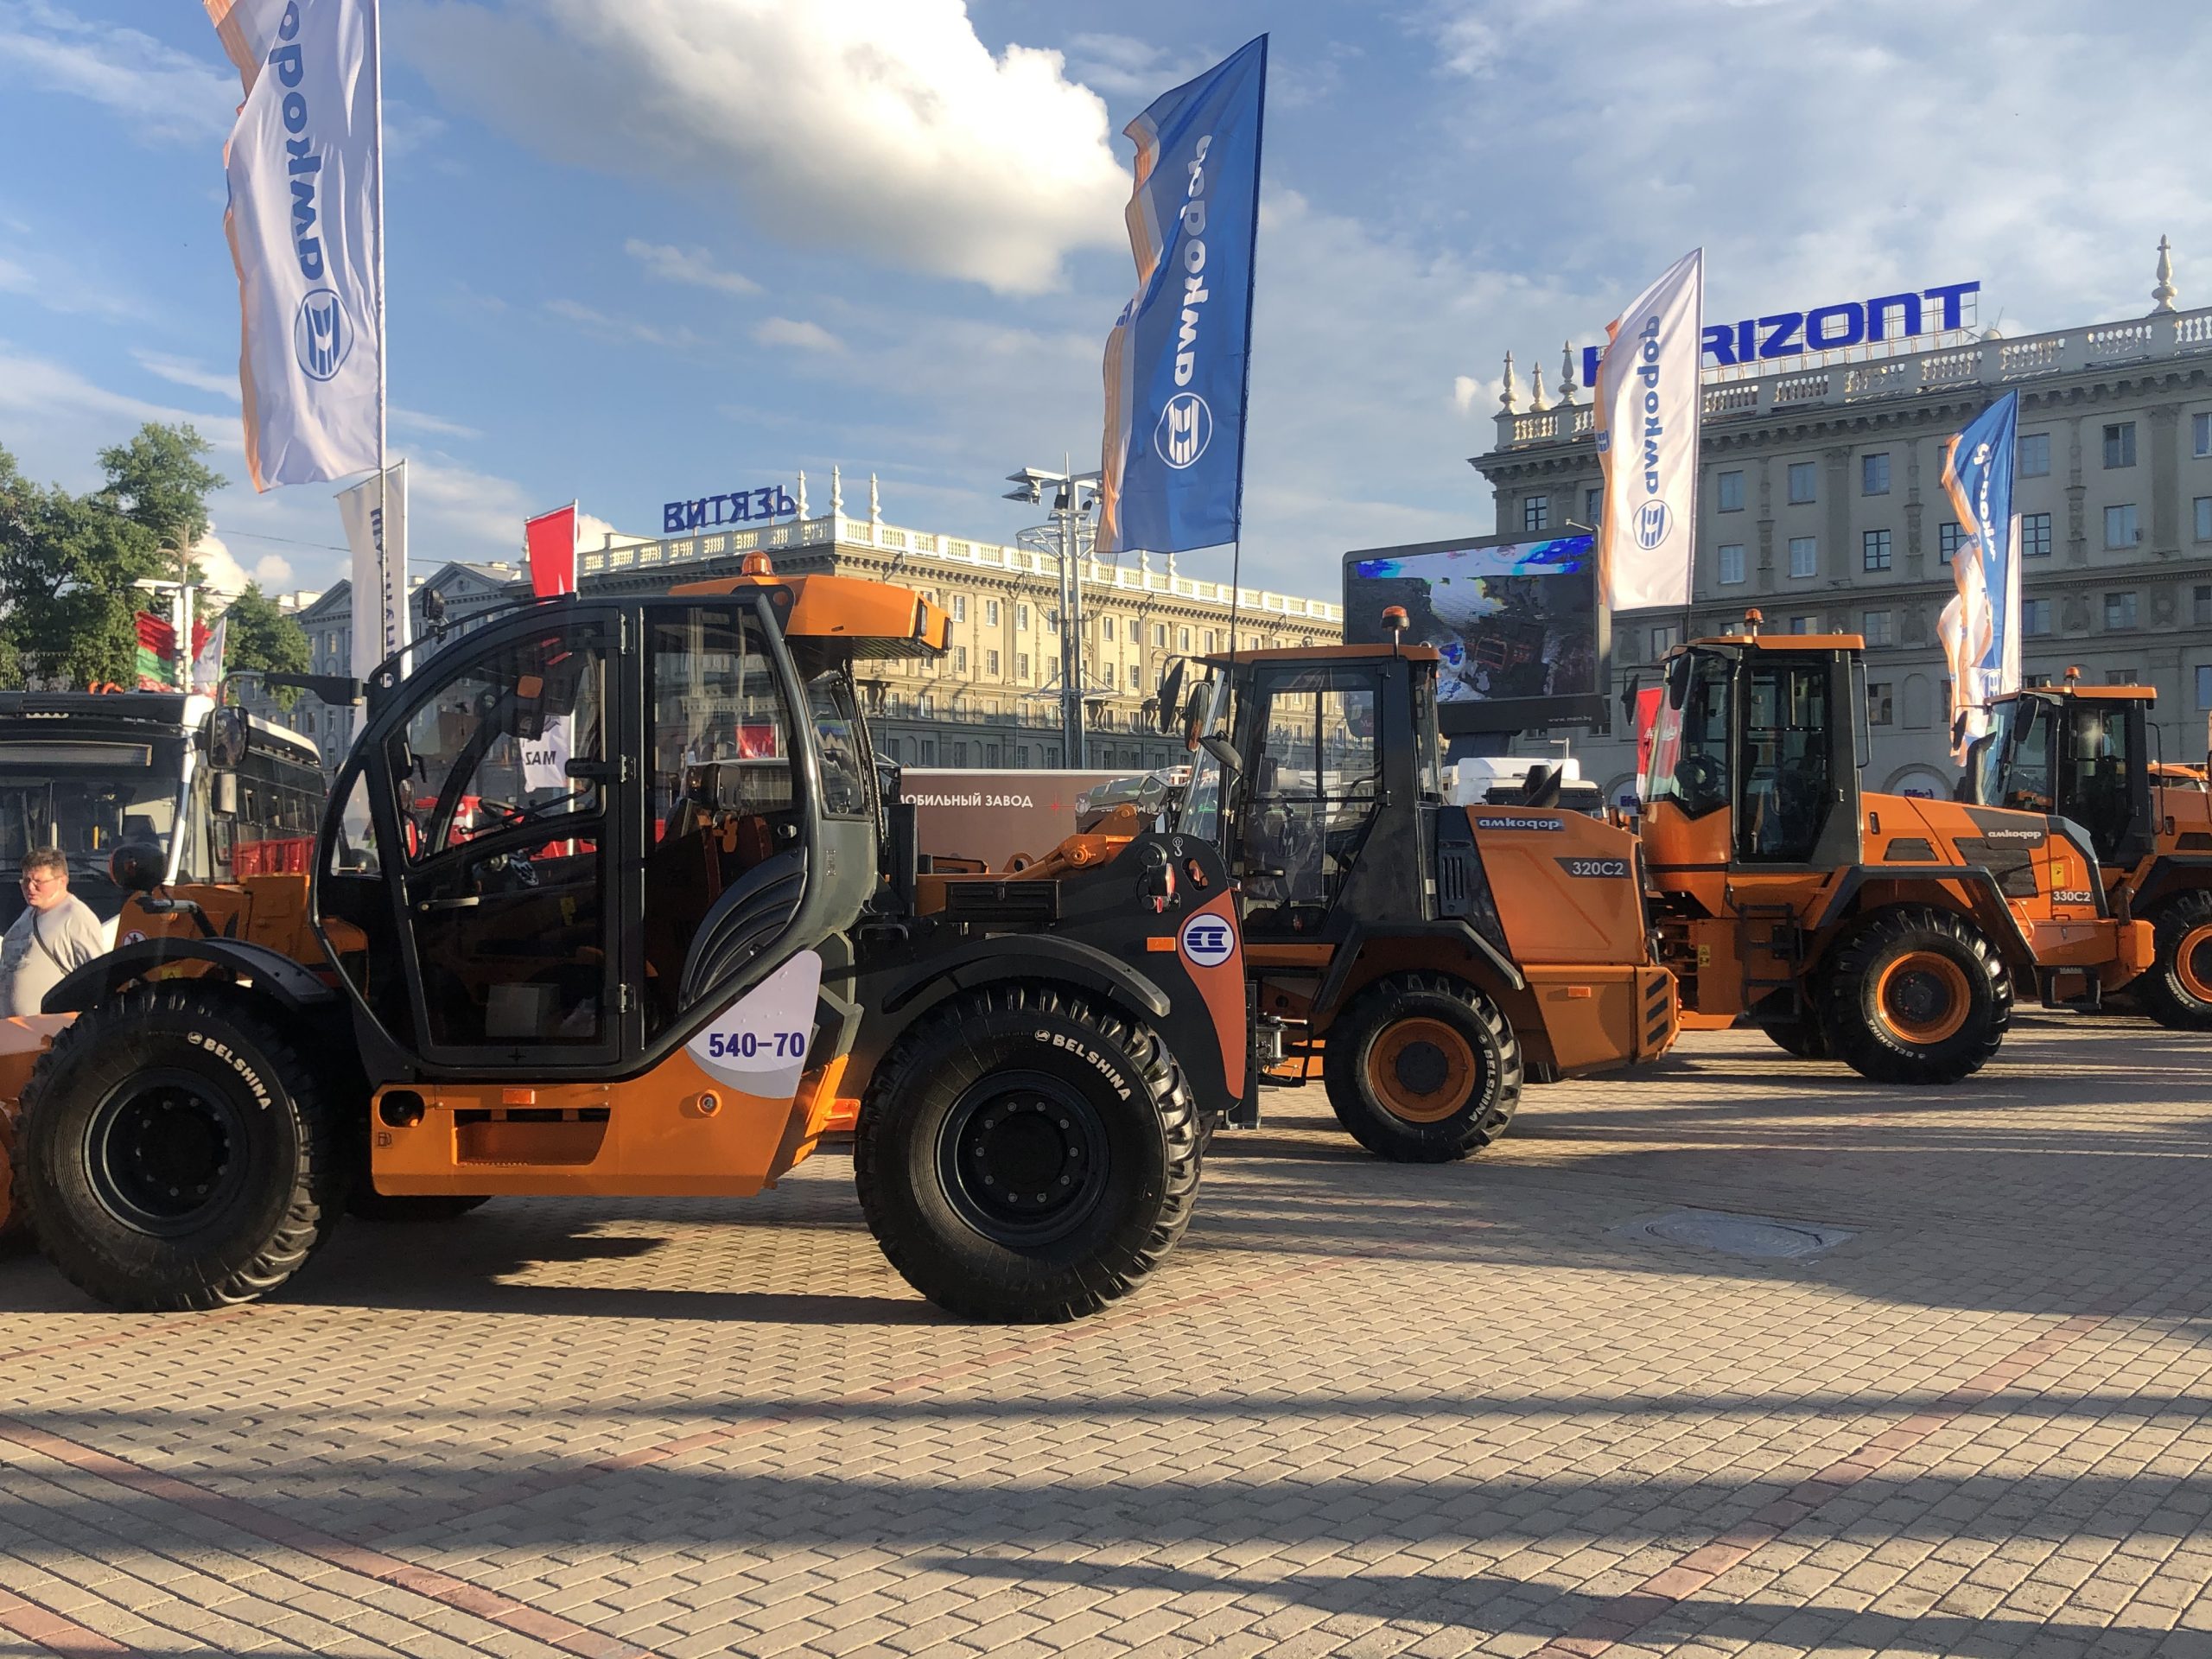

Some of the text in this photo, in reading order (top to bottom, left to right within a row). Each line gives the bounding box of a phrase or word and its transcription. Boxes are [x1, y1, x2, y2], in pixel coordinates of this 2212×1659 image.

[1583, 280, 1980, 388] RIZONT
[664, 485, 798, 533] ВИТЯЗЬ
[985, 794, 1033, 809] ЗАВОД
[1572, 861, 1624, 876] 320C2
[2052, 891, 2091, 902] 330C2
[709, 1032, 805, 1058] 540-70
[1052, 1033, 1132, 1102] BELSHINA
[203, 1038, 272, 1110] BELSHINA
[1468, 1049, 1497, 1122] BELSHINA
